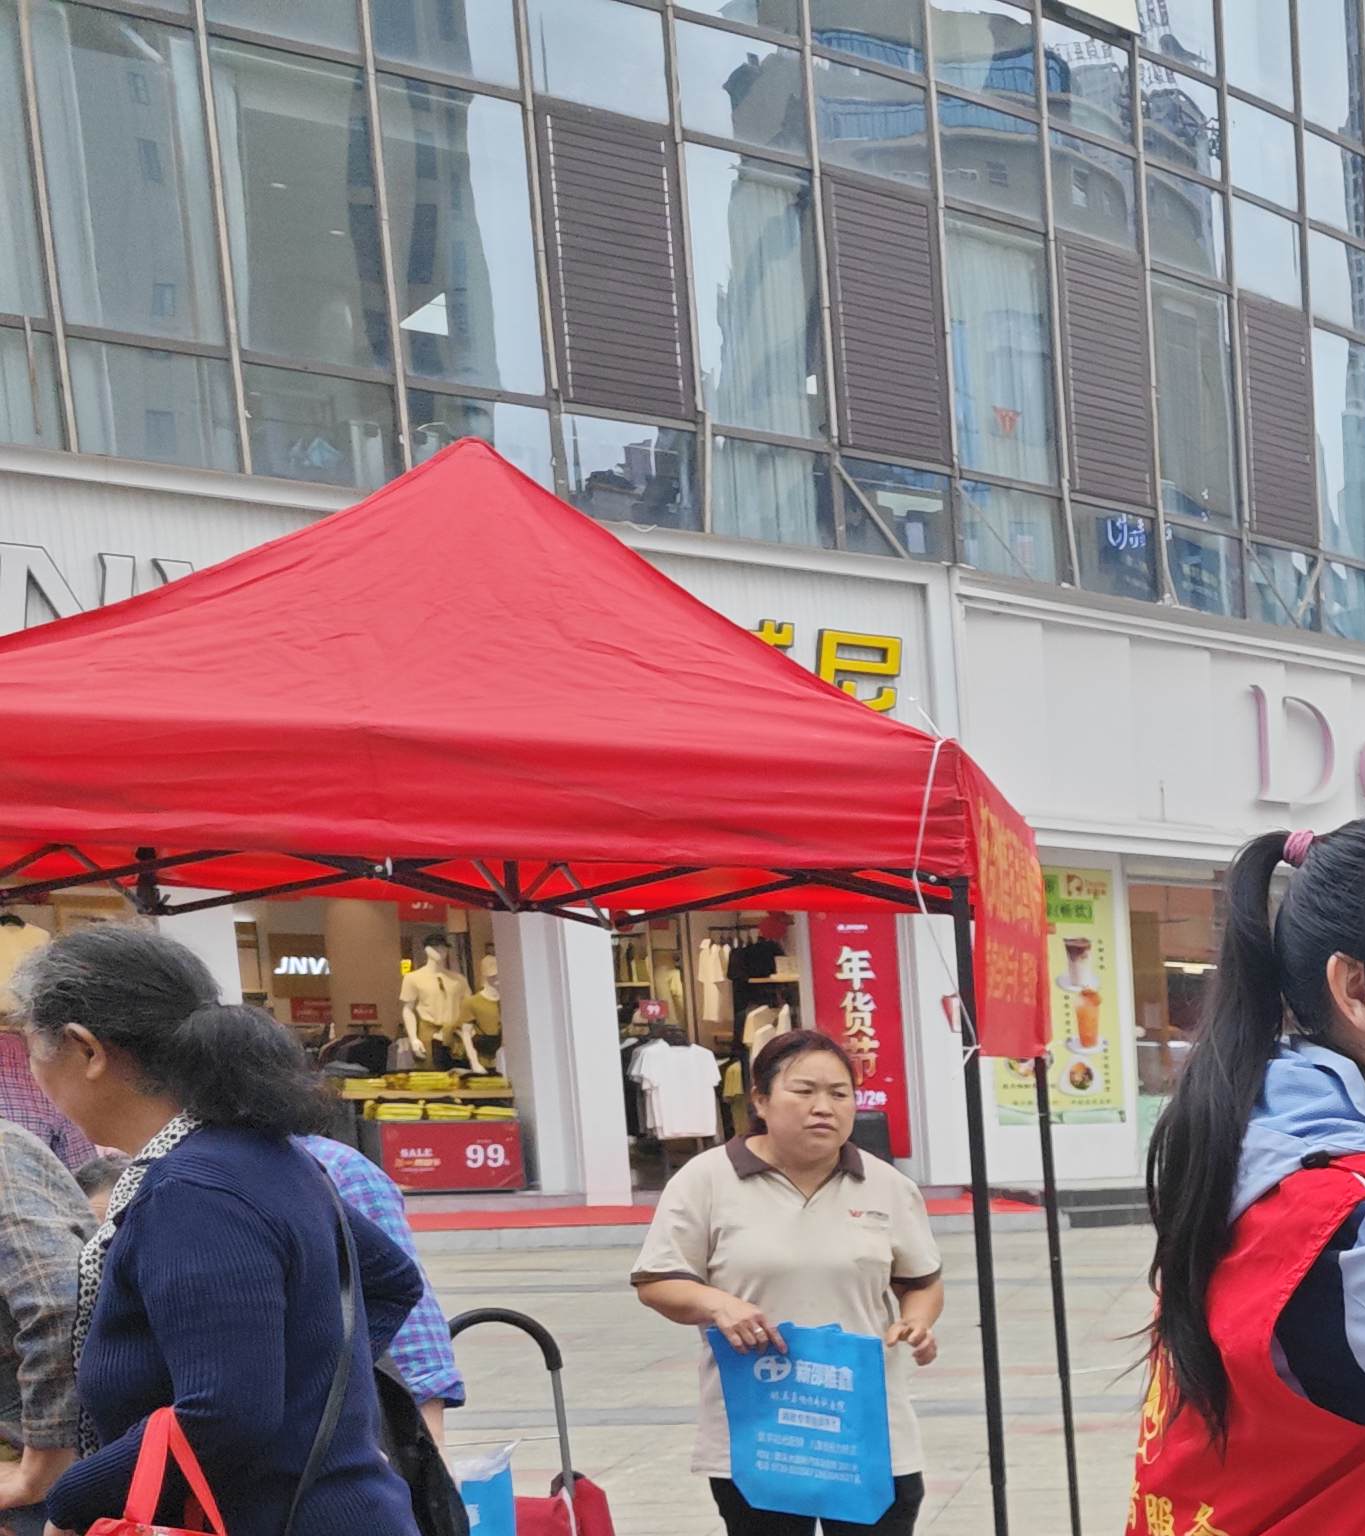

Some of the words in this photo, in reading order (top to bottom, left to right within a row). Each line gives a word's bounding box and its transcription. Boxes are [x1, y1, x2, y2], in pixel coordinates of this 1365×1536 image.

[835, 945, 880, 1086] 年货节
[465, 1144, 505, 1168] 99
